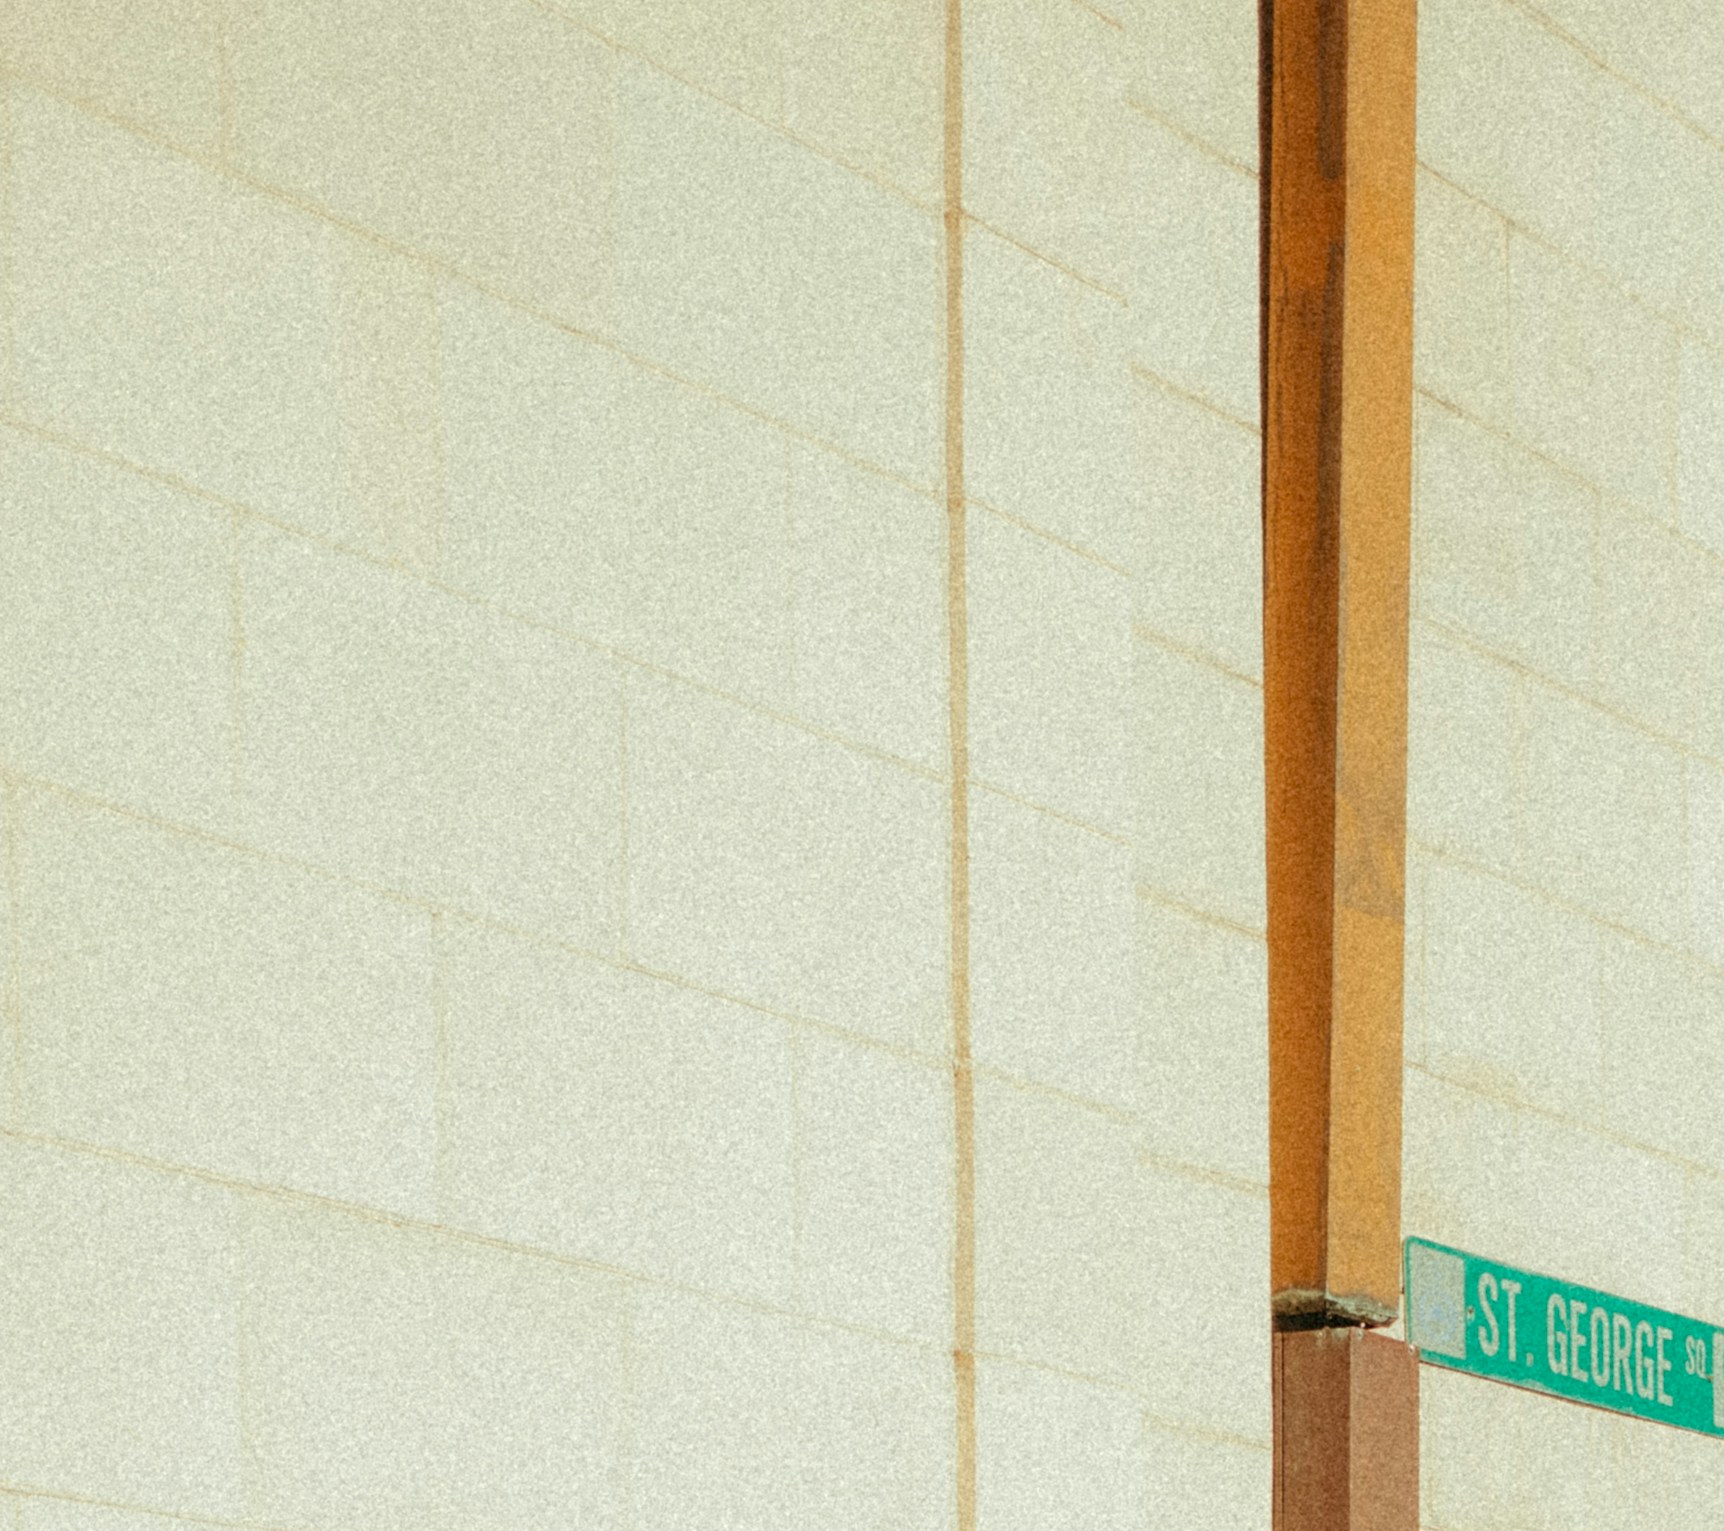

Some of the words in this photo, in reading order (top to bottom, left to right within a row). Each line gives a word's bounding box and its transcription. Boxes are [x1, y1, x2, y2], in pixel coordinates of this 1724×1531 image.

[1477, 1271, 1534, 1367] ST.
[1546, 1293, 1674, 1407] GEORGE
[1685, 1334, 1708, 1380] SQ
